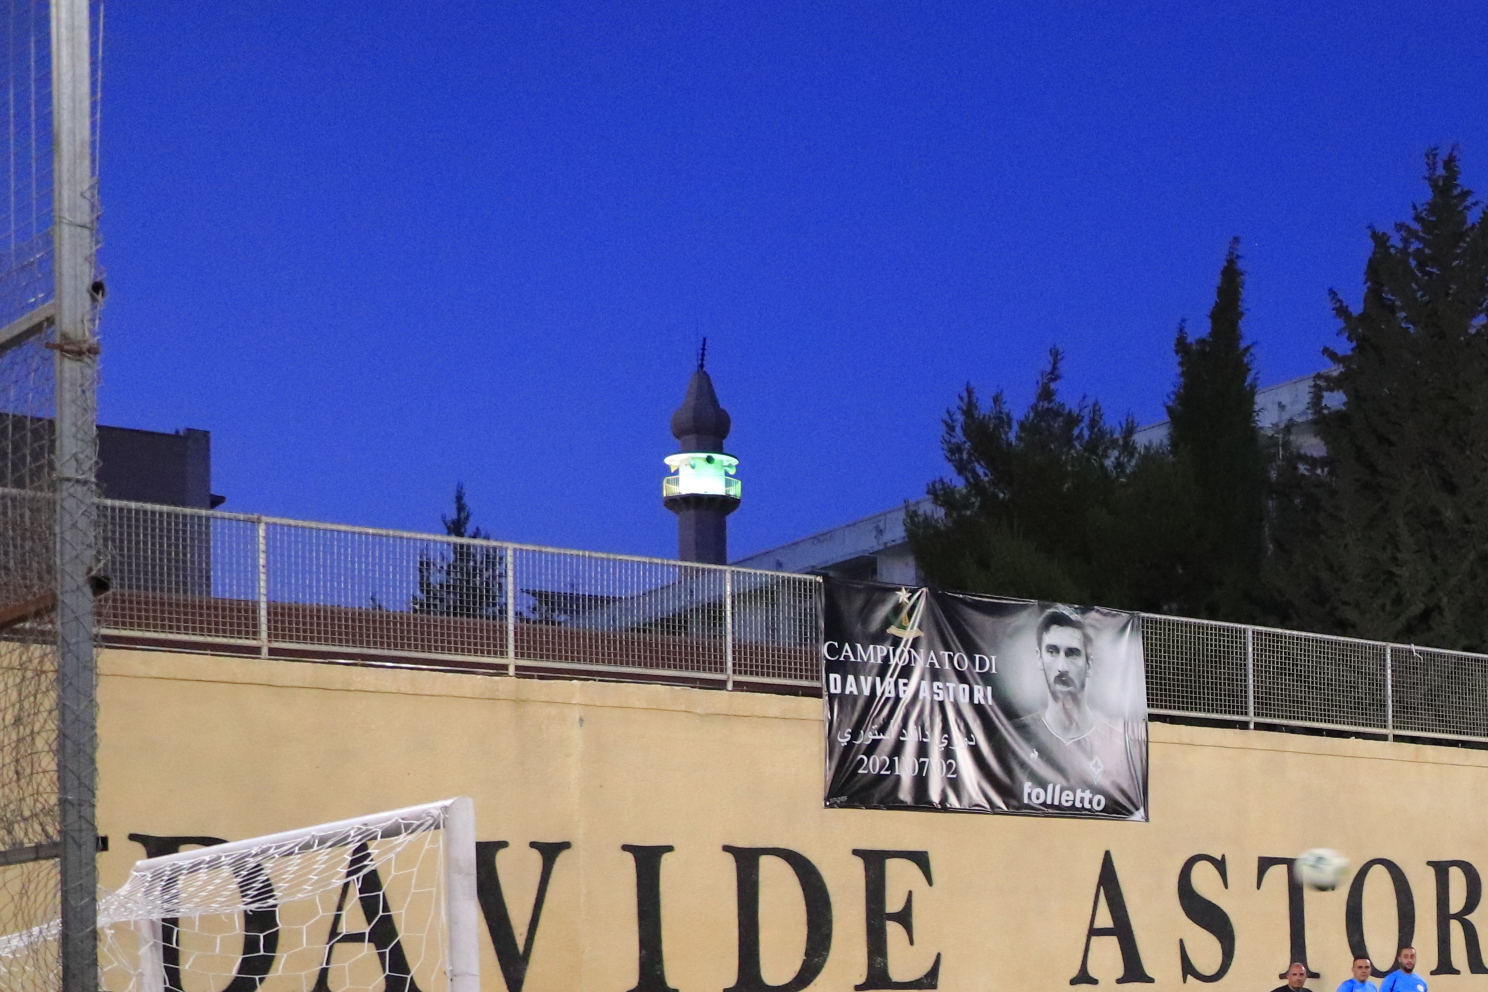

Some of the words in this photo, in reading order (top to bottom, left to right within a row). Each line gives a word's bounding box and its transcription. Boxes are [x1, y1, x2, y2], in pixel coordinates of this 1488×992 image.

[824, 641, 968, 672] CAMPIONATO
[974, 654, 998, 674] DI
[828, 673, 909, 699] DAVIDE
[919, 681, 993, 706] ASTORI
[1023, 781, 1106, 811] folletto
